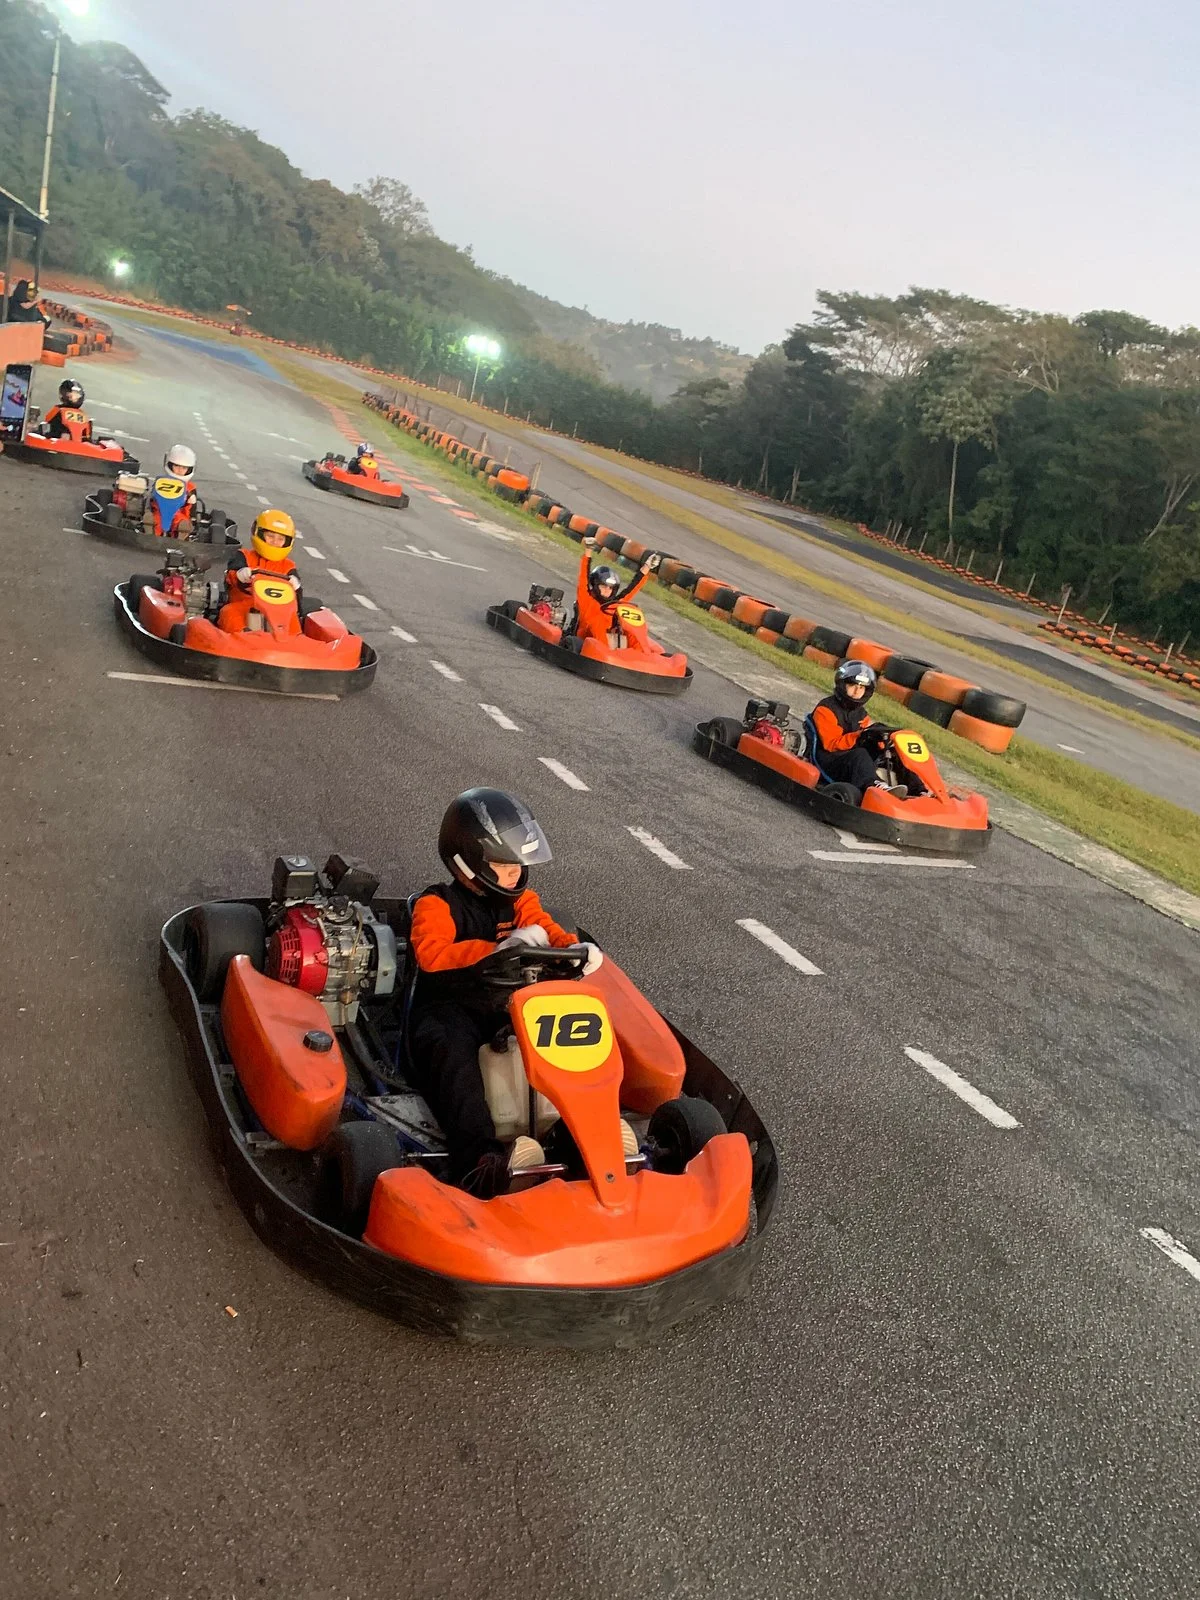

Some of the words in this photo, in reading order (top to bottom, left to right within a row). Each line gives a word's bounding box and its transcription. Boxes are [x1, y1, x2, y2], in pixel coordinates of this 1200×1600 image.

[158, 482, 183, 494] 21
[264, 587, 285, 599] 6
[621, 608, 642, 622] 23
[907, 742, 922, 755] 8
[535, 1012, 603, 1048] 18
